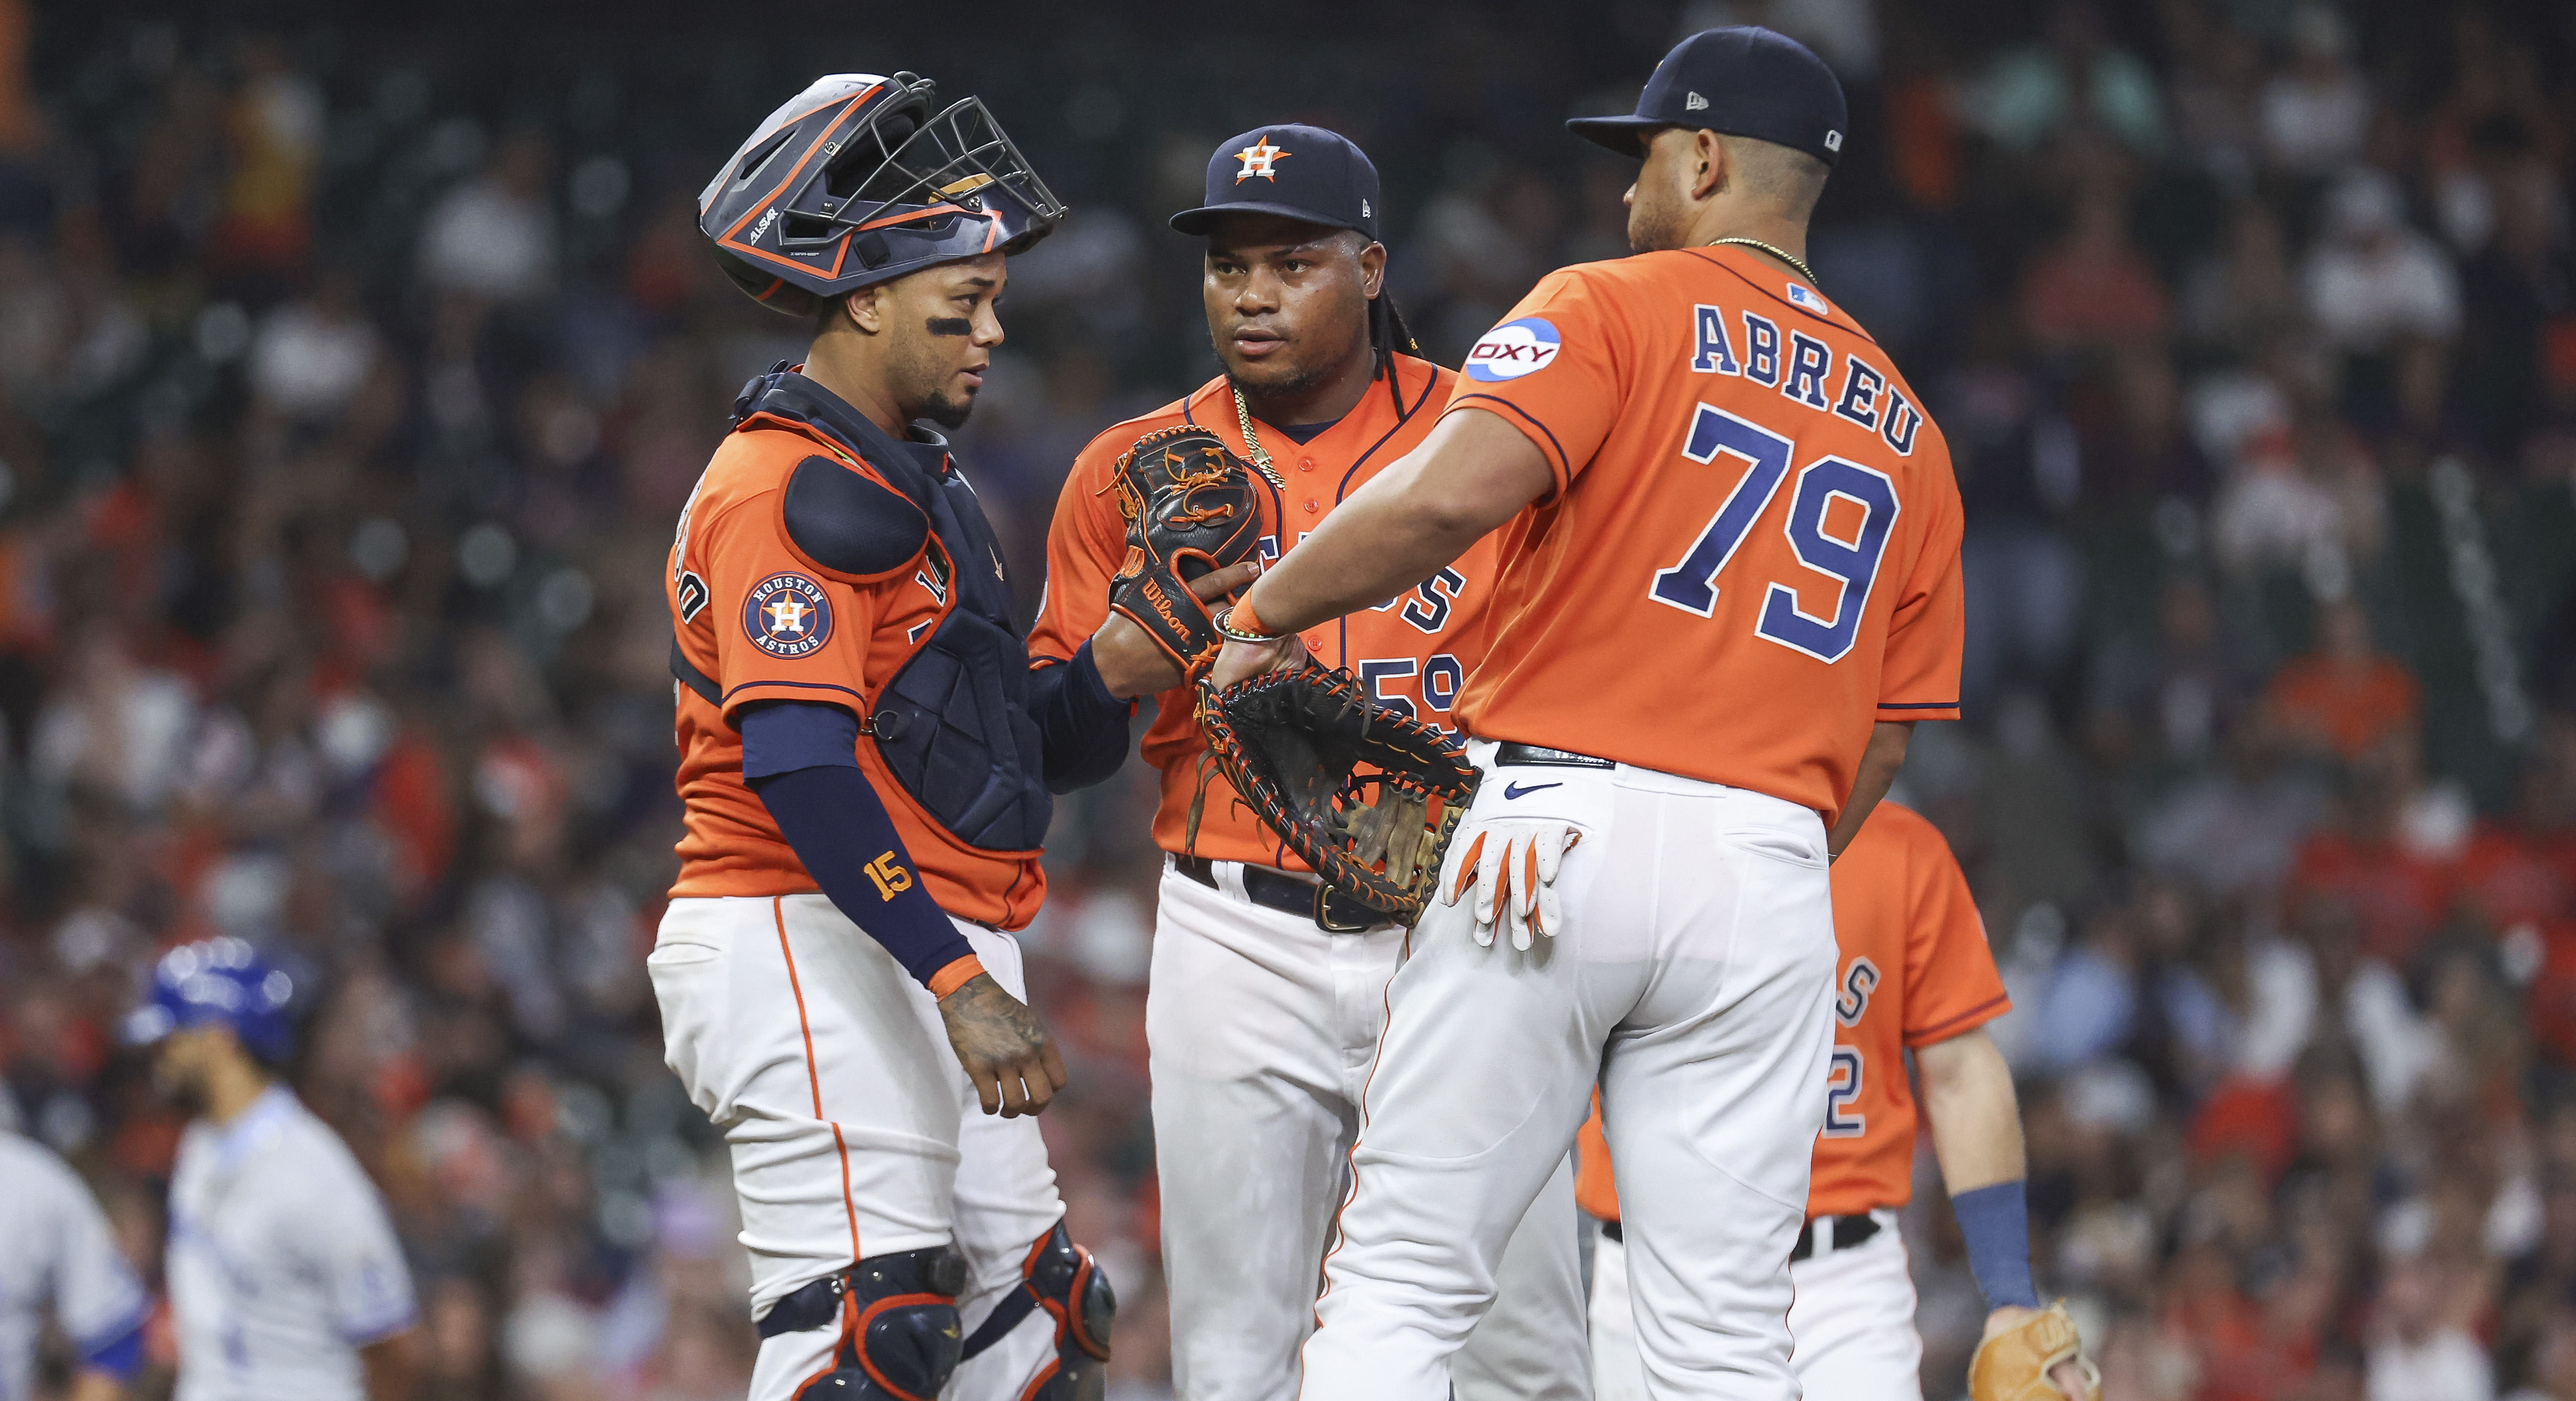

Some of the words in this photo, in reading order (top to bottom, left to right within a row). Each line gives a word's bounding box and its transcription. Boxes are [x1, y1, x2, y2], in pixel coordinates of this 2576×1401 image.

[1472, 343, 1556, 362] OXY
[1690, 303, 1923, 457] ABREU
[1648, 401, 1901, 664] 79
[753, 577, 824, 604] HOUSTON
[1142, 576, 1191, 642] Wilson
[771, 602, 805, 632] H
[755, 635, 819, 654] ASTROS
[863, 850, 912, 902] 15
